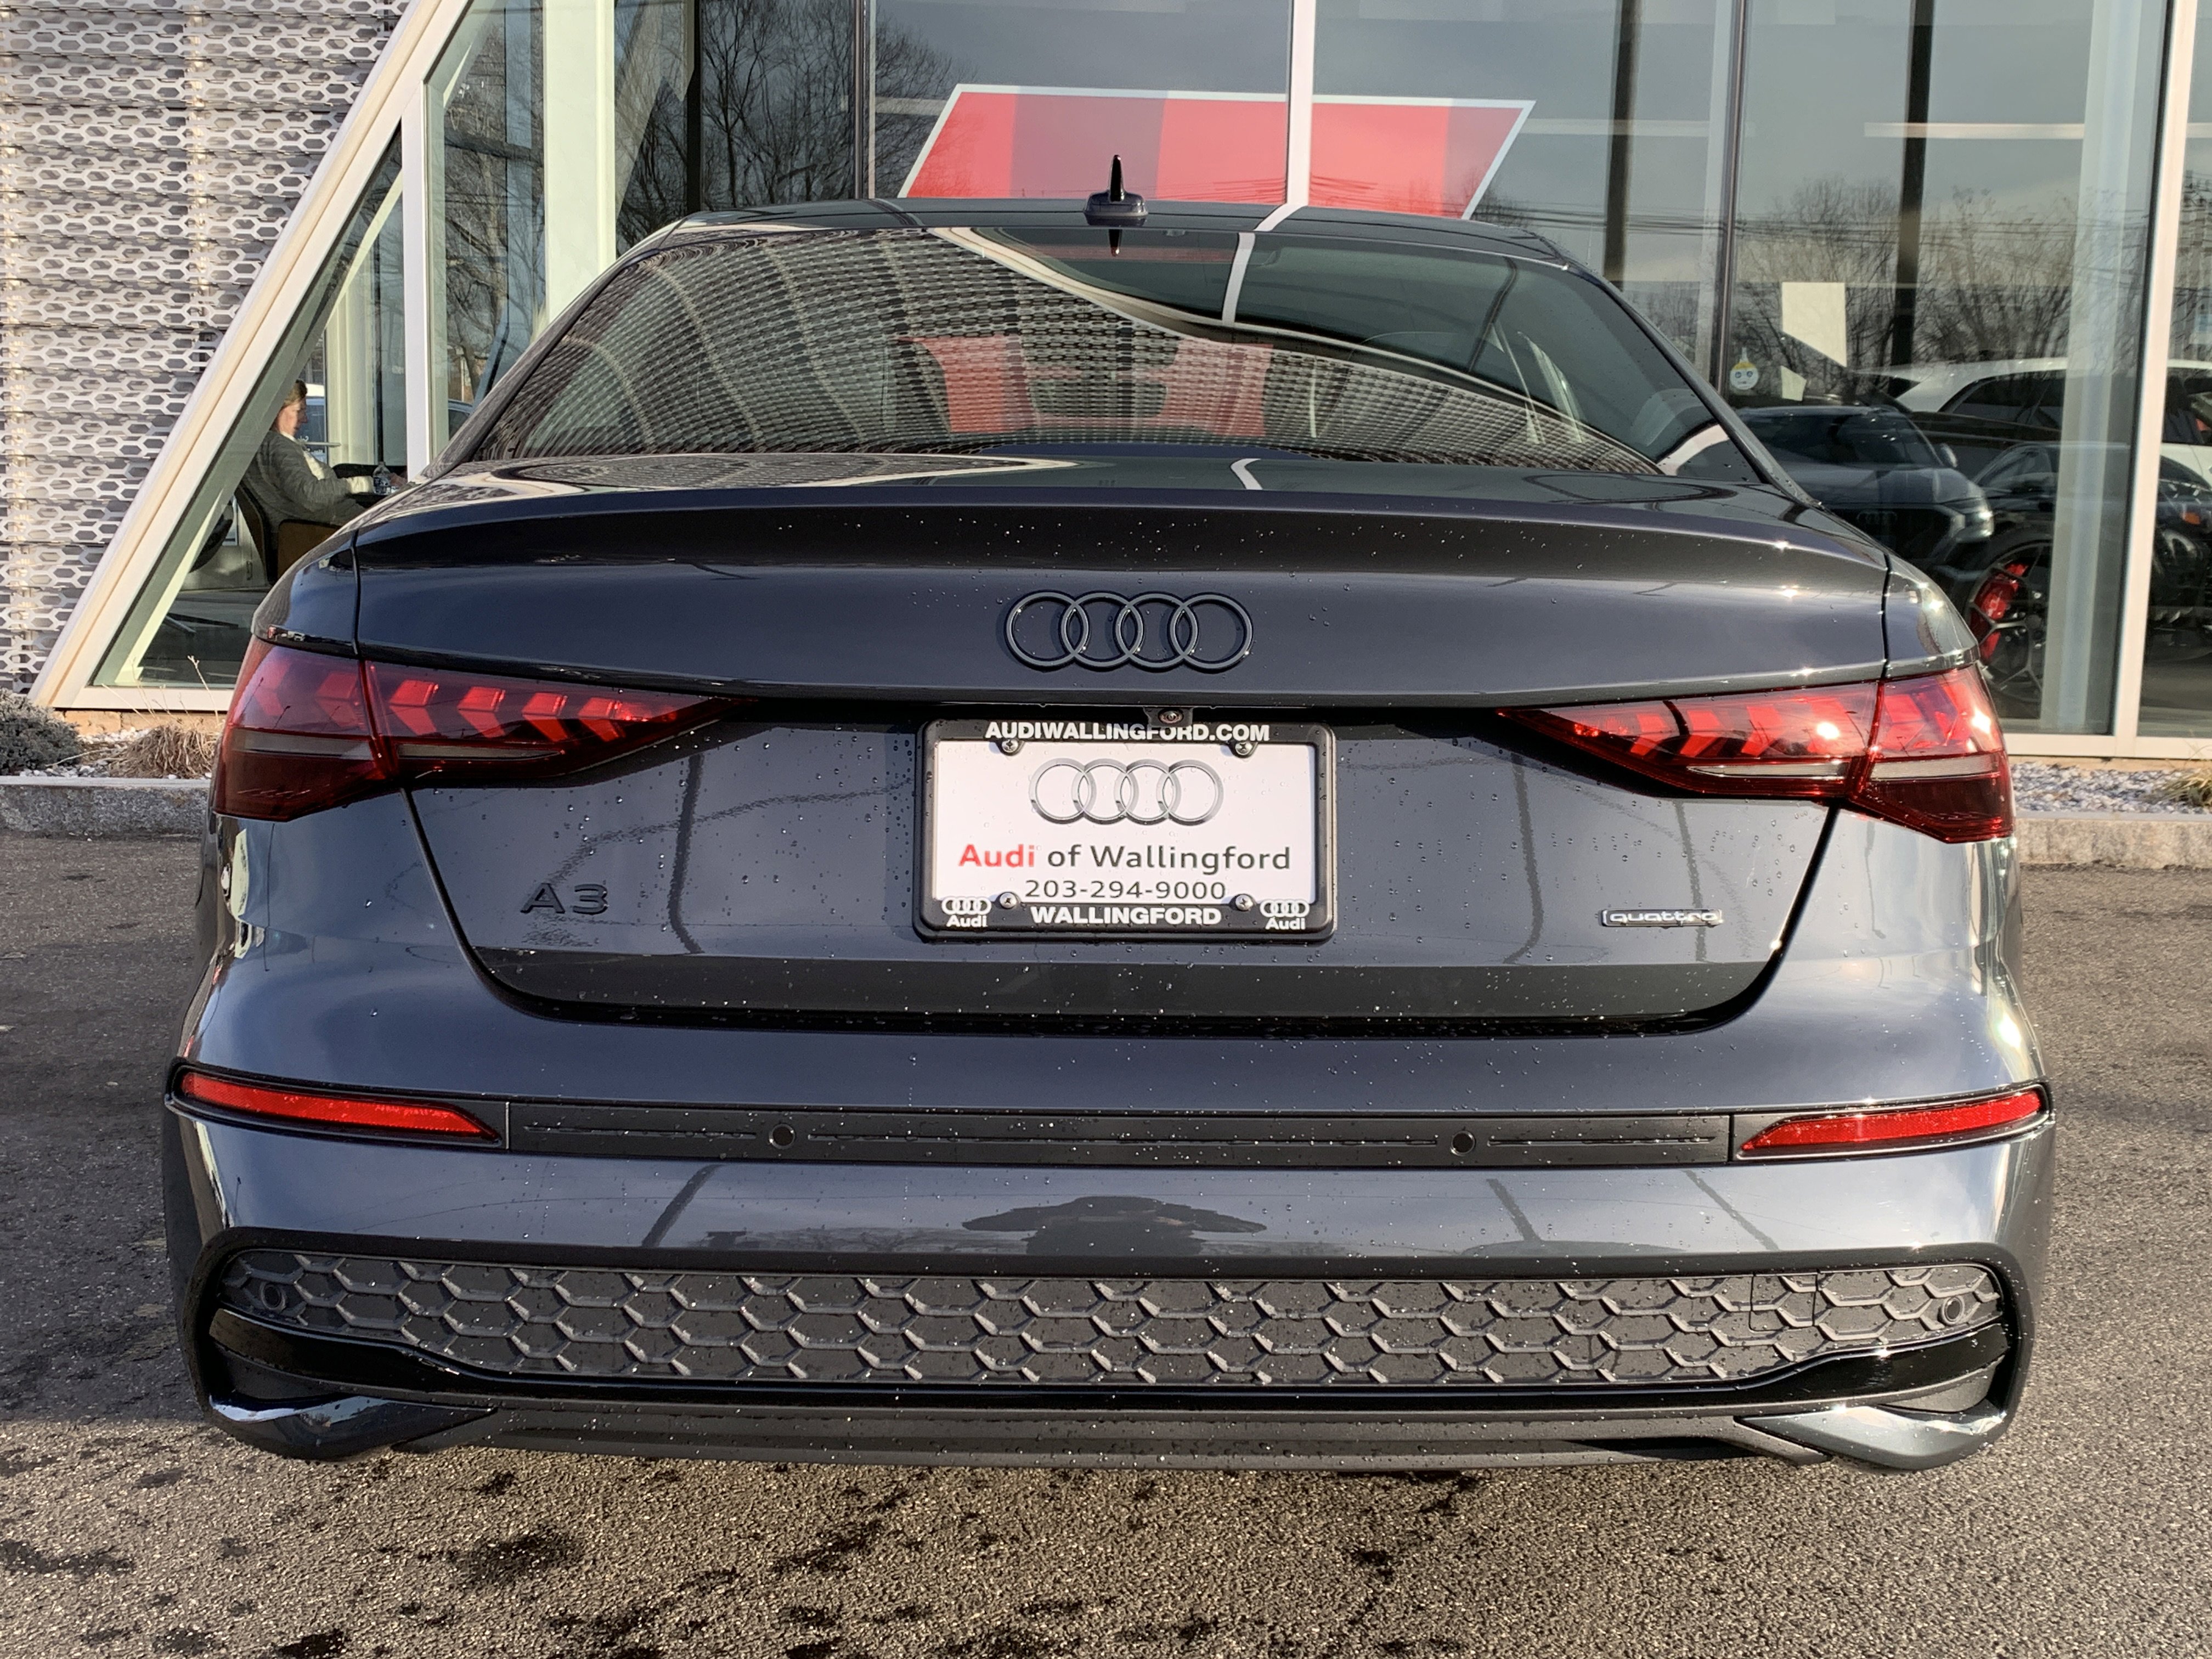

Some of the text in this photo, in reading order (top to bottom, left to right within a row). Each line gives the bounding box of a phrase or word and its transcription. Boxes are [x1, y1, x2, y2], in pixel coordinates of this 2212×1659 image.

[985, 721, 1269, 741] AUDIWALLINGFORD.COM
[958, 844, 1290, 875] Audi of Wallingford
[1025, 880, 1225, 899] 203-294-9000
[520, 883, 608, 915] A3
[946, 915, 987, 928] Audi
[1030, 906, 1222, 924] WALLINGFORD
[1265, 917, 1305, 930] Audi
[1610, 911, 1718, 924] quattro
